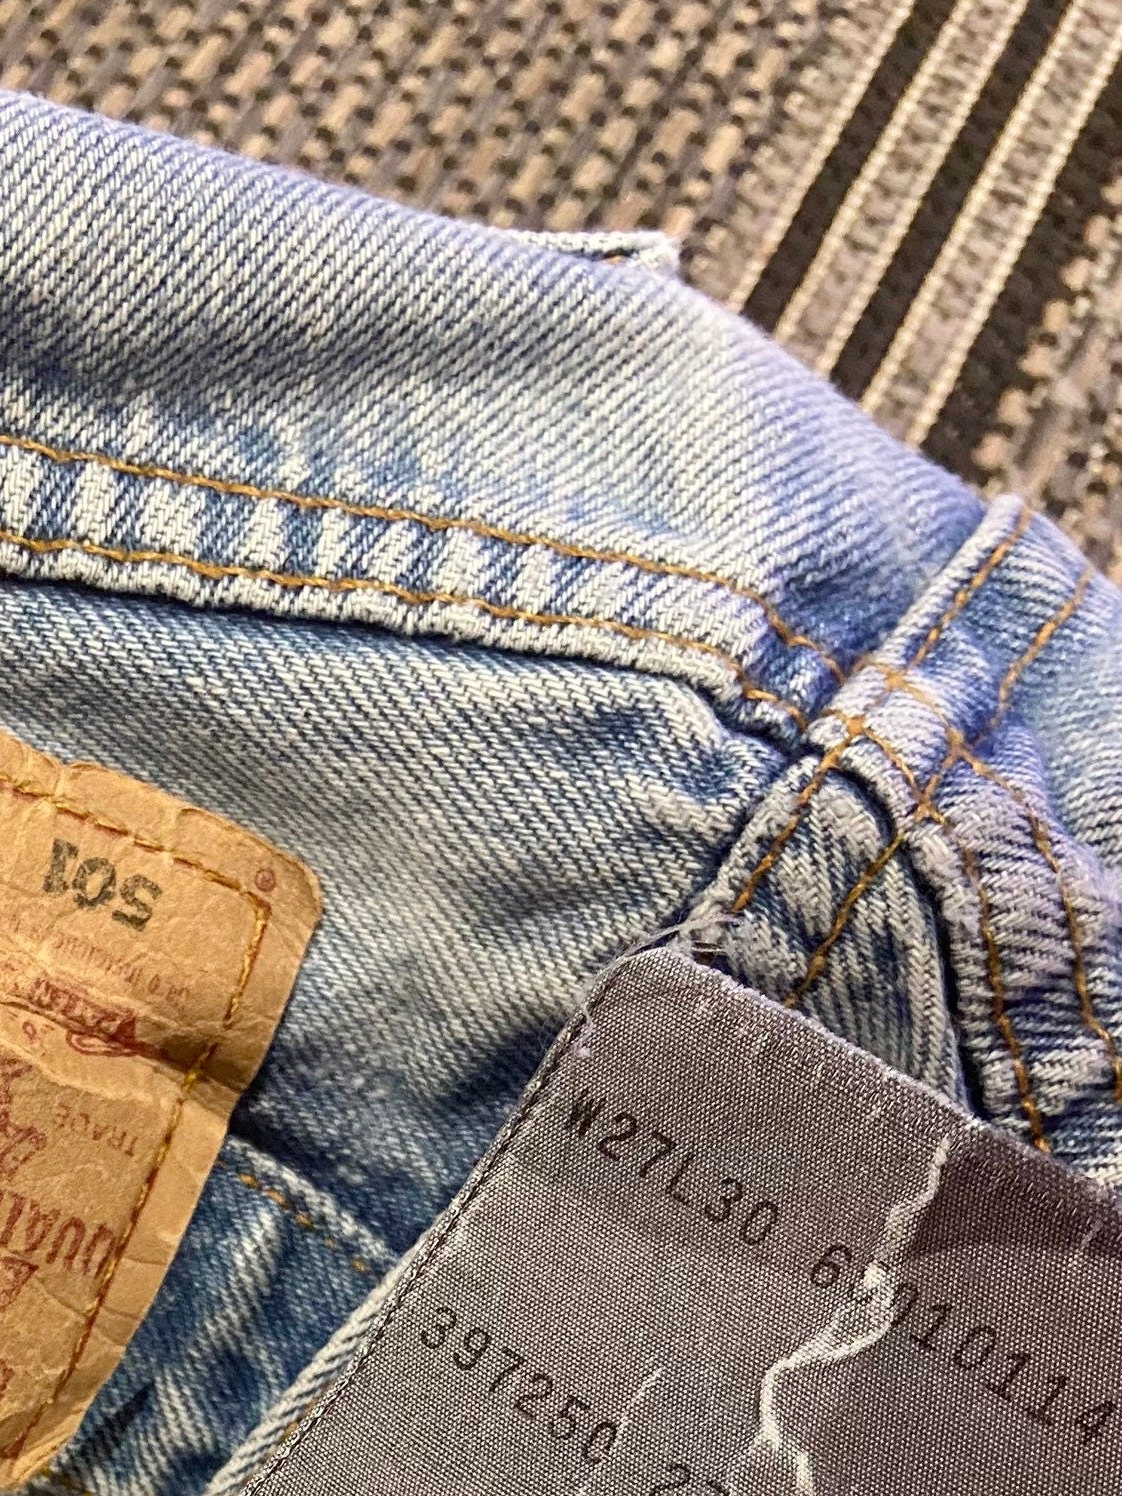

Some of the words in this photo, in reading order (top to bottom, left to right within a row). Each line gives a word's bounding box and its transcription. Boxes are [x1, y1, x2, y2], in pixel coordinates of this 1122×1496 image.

[36, 836, 164, 931] 501
[50, 1102, 140, 1156] TRADE
[566, 1087, 779, 1247] W27L30
[809, 1243, 1116, 1446] 6010114
[420, 1306, 619, 1467] 397250
